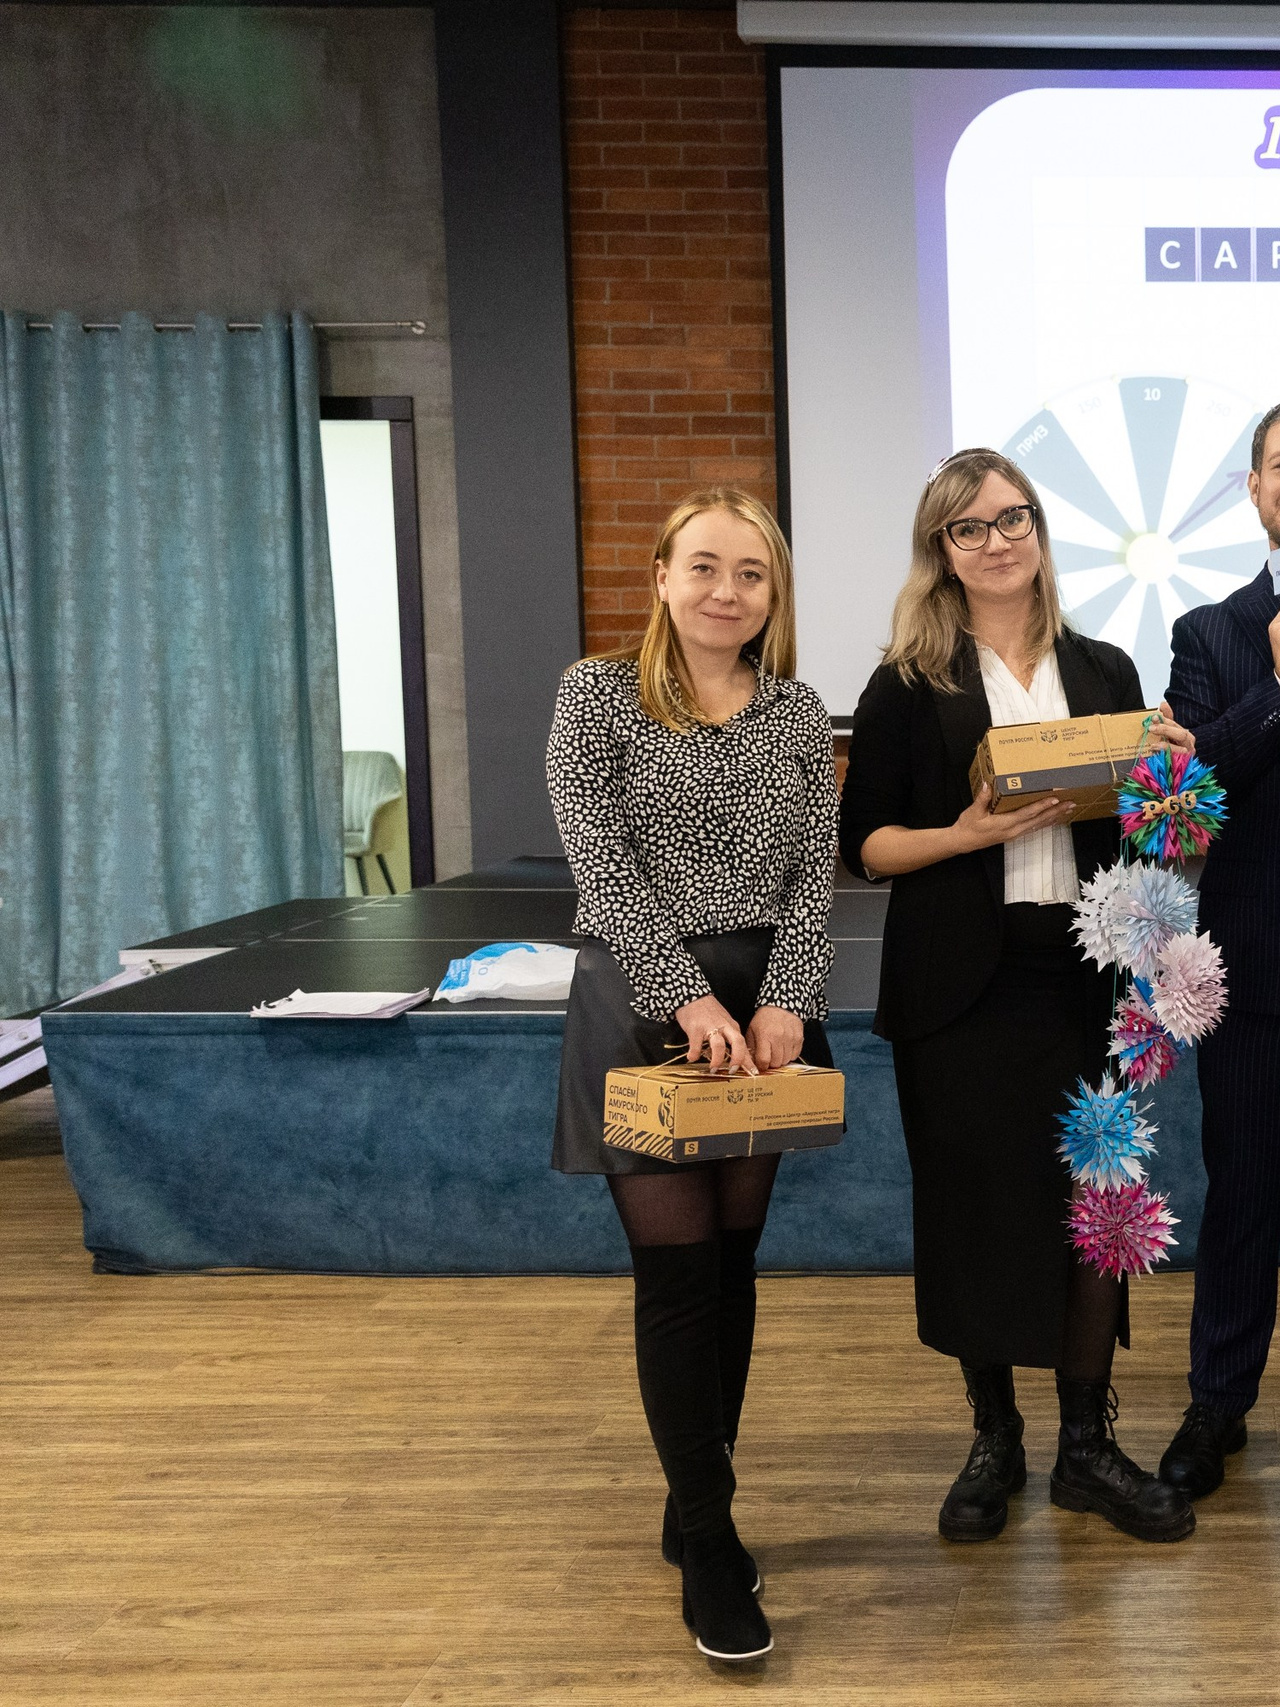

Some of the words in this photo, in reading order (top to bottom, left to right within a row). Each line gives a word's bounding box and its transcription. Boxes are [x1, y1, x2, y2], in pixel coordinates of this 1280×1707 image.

[1143, 387, 1162, 401] 10
[1015, 423, 1050, 457] ПРИЗ
[1010, 778, 1019, 788] S
[609, 1084, 636, 1098] СПАСЁМ
[608, 1098, 648, 1115] АМУРСКОГО
[608, 1110, 628, 1123] ТИГРА
[687, 1143, 696, 1153] S
